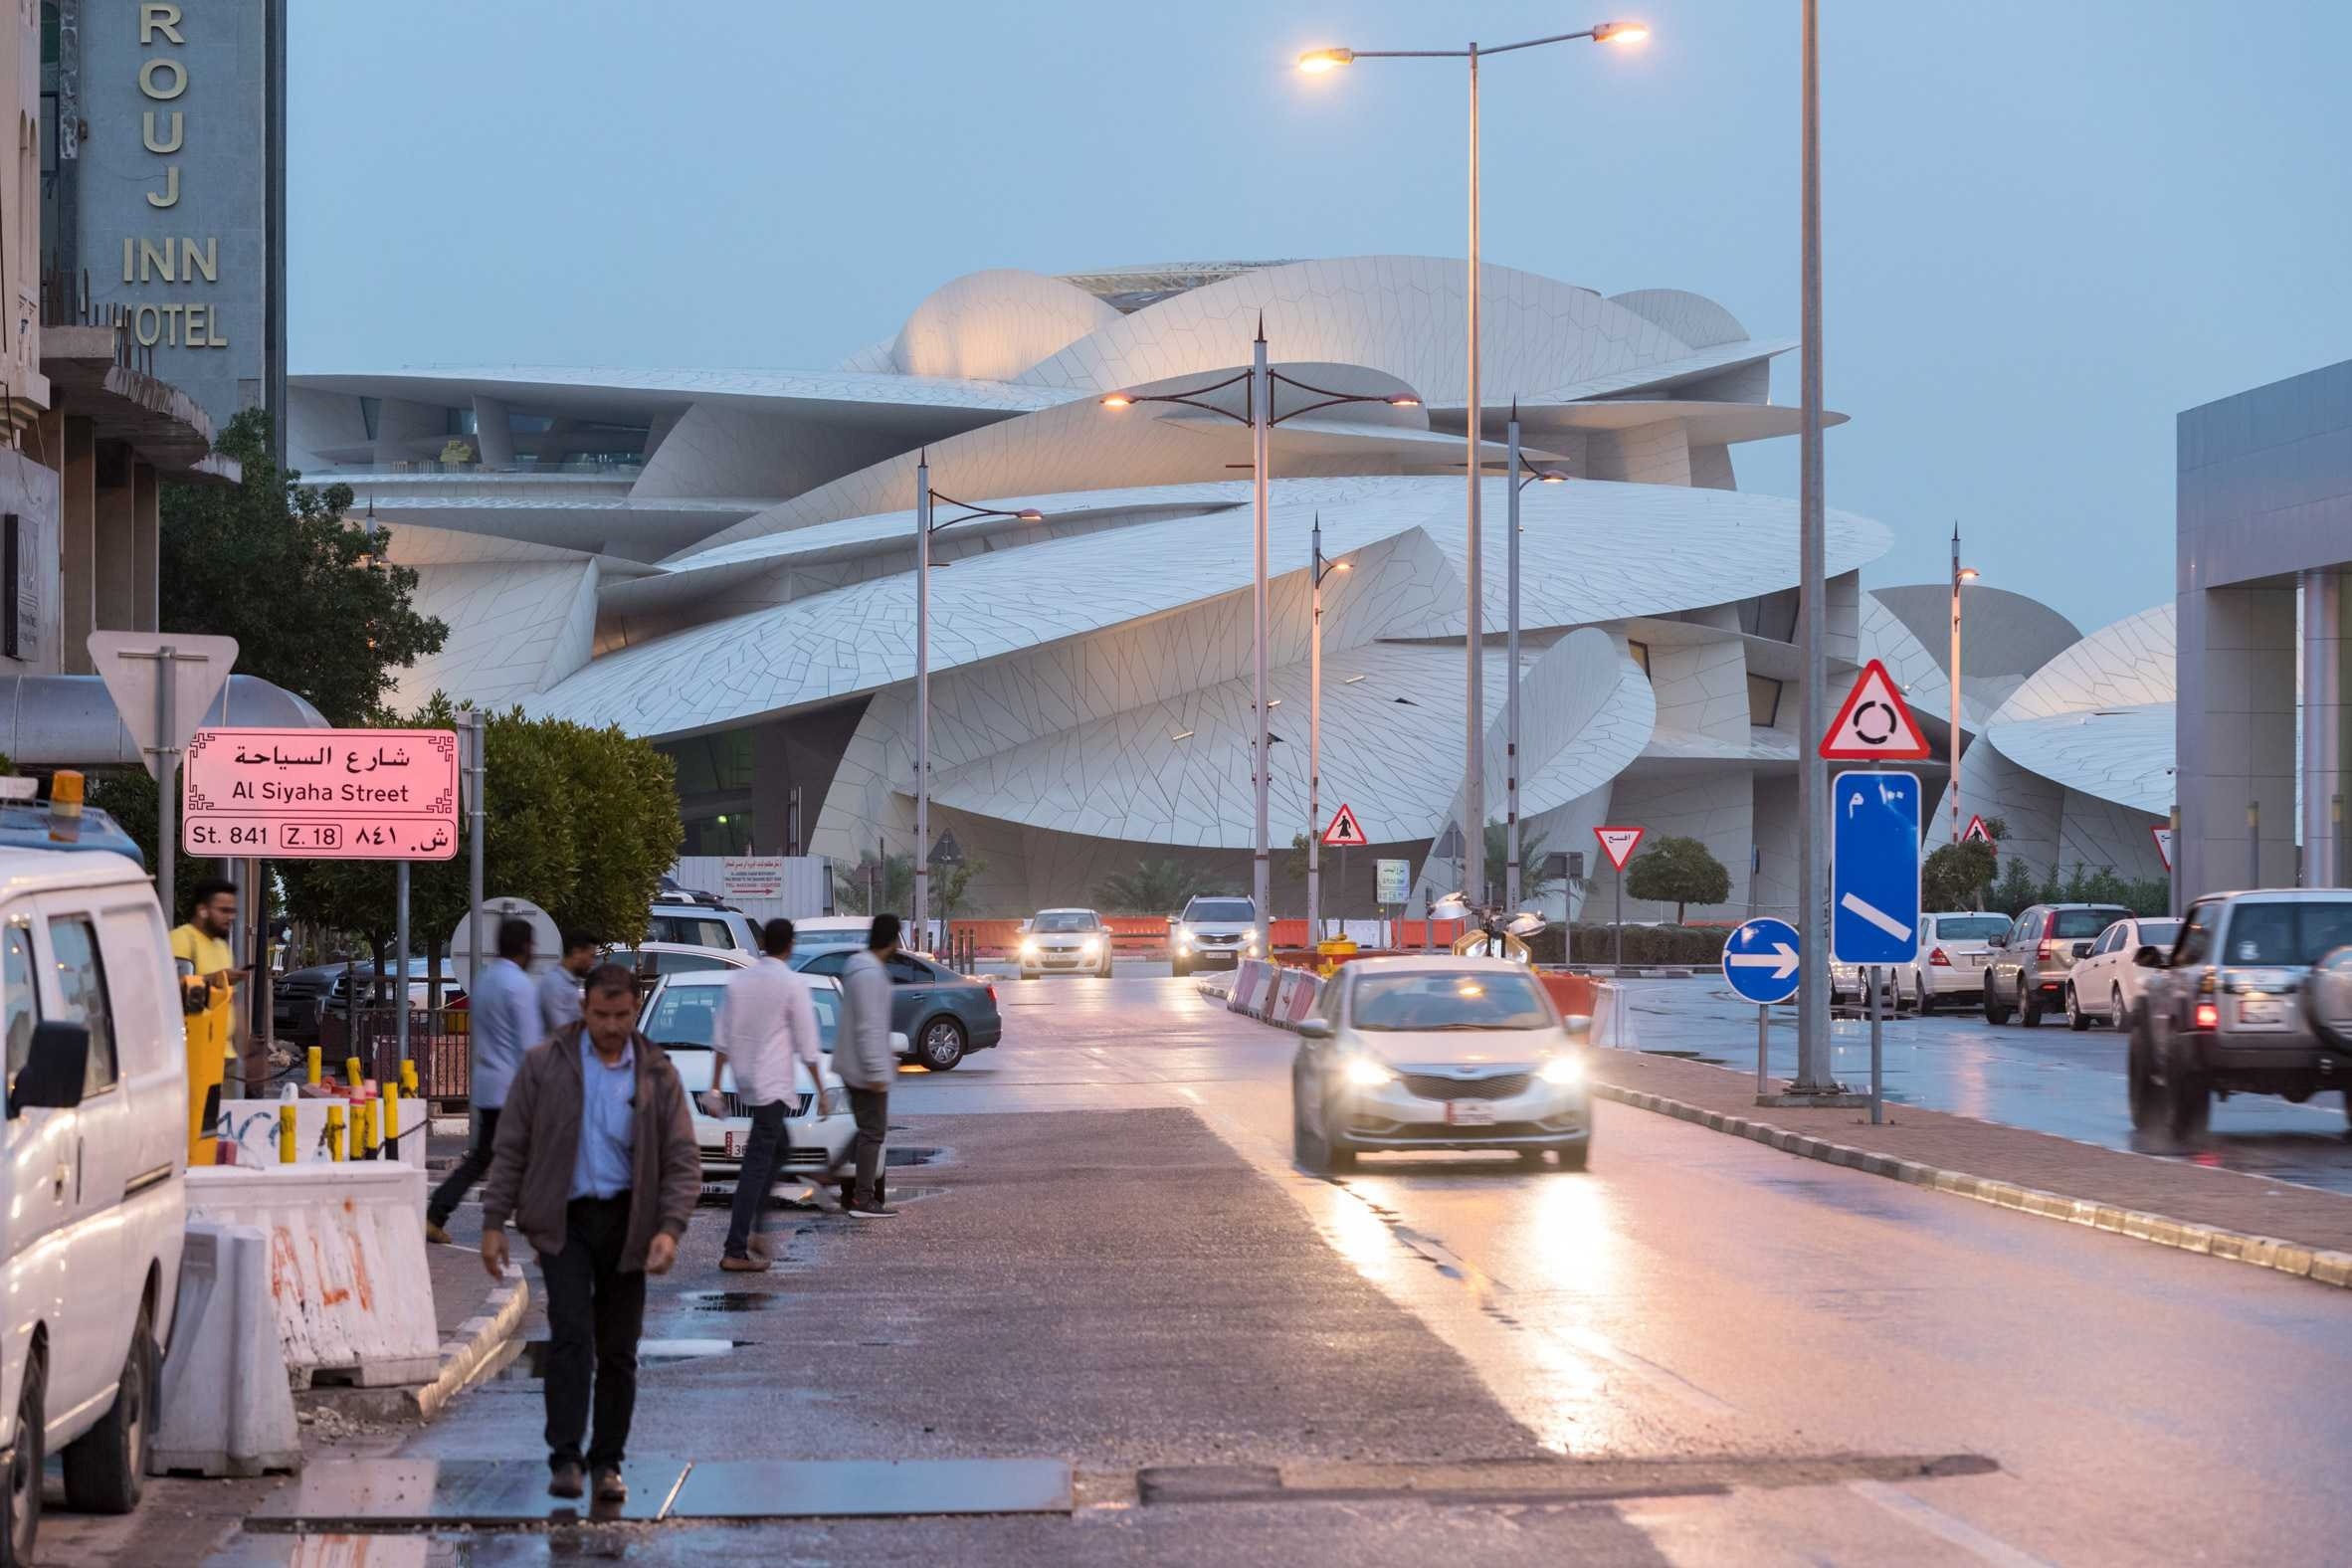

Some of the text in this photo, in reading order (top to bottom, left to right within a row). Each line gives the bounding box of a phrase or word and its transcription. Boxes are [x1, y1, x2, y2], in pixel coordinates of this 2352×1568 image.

[122, 238, 217, 283] INN
[234, 745, 410, 773] شارع السياحة
[232, 781, 409, 803] Al Siyaha Street
[192, 826, 267, 845] St. 841
[287, 828, 336, 845] Z. 18
[355, 827, 396, 845] ٨٤١
